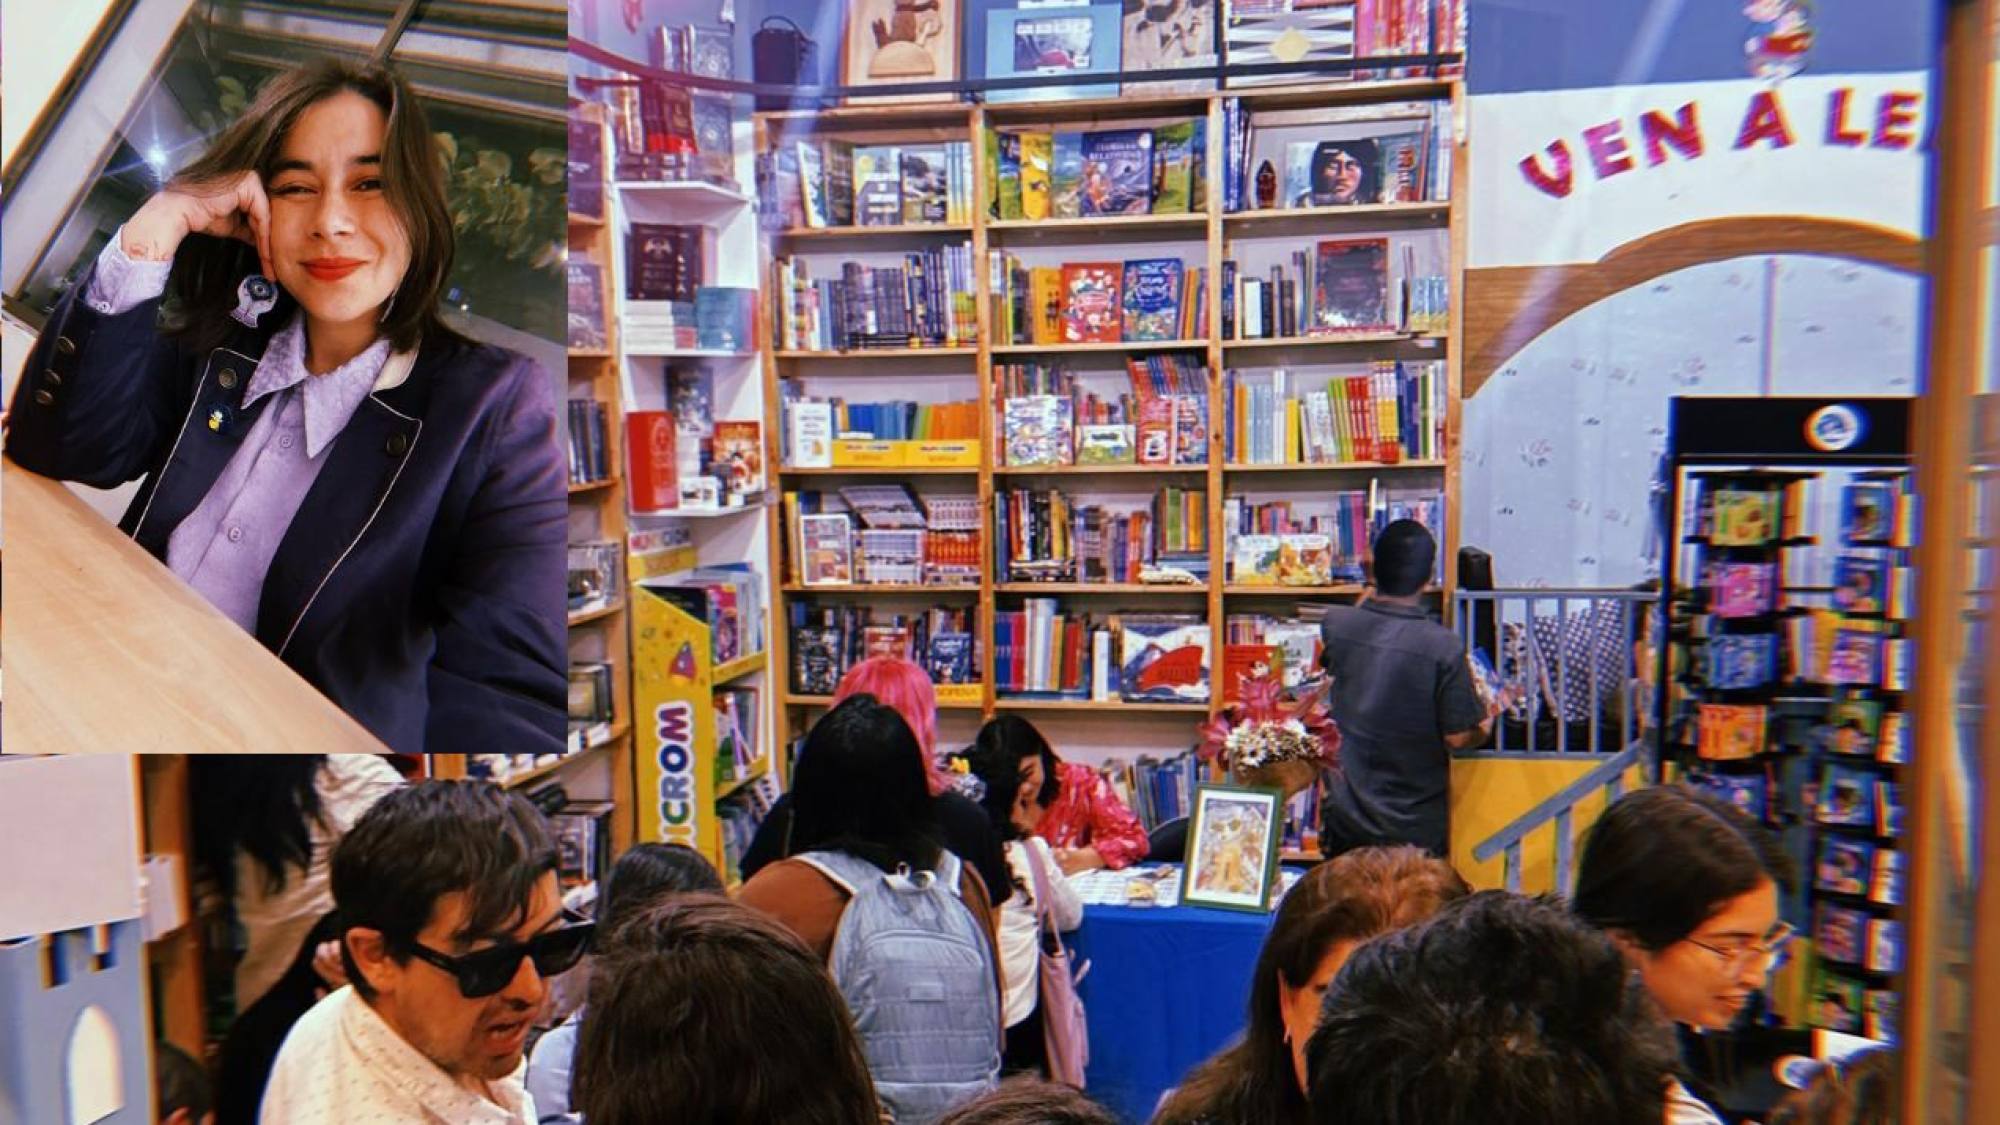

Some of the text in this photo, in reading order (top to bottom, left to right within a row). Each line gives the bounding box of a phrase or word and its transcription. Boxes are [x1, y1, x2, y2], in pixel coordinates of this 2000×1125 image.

[1518, 87, 1922, 199] VEN A LE
[657, 703, 694, 845] ICROM
